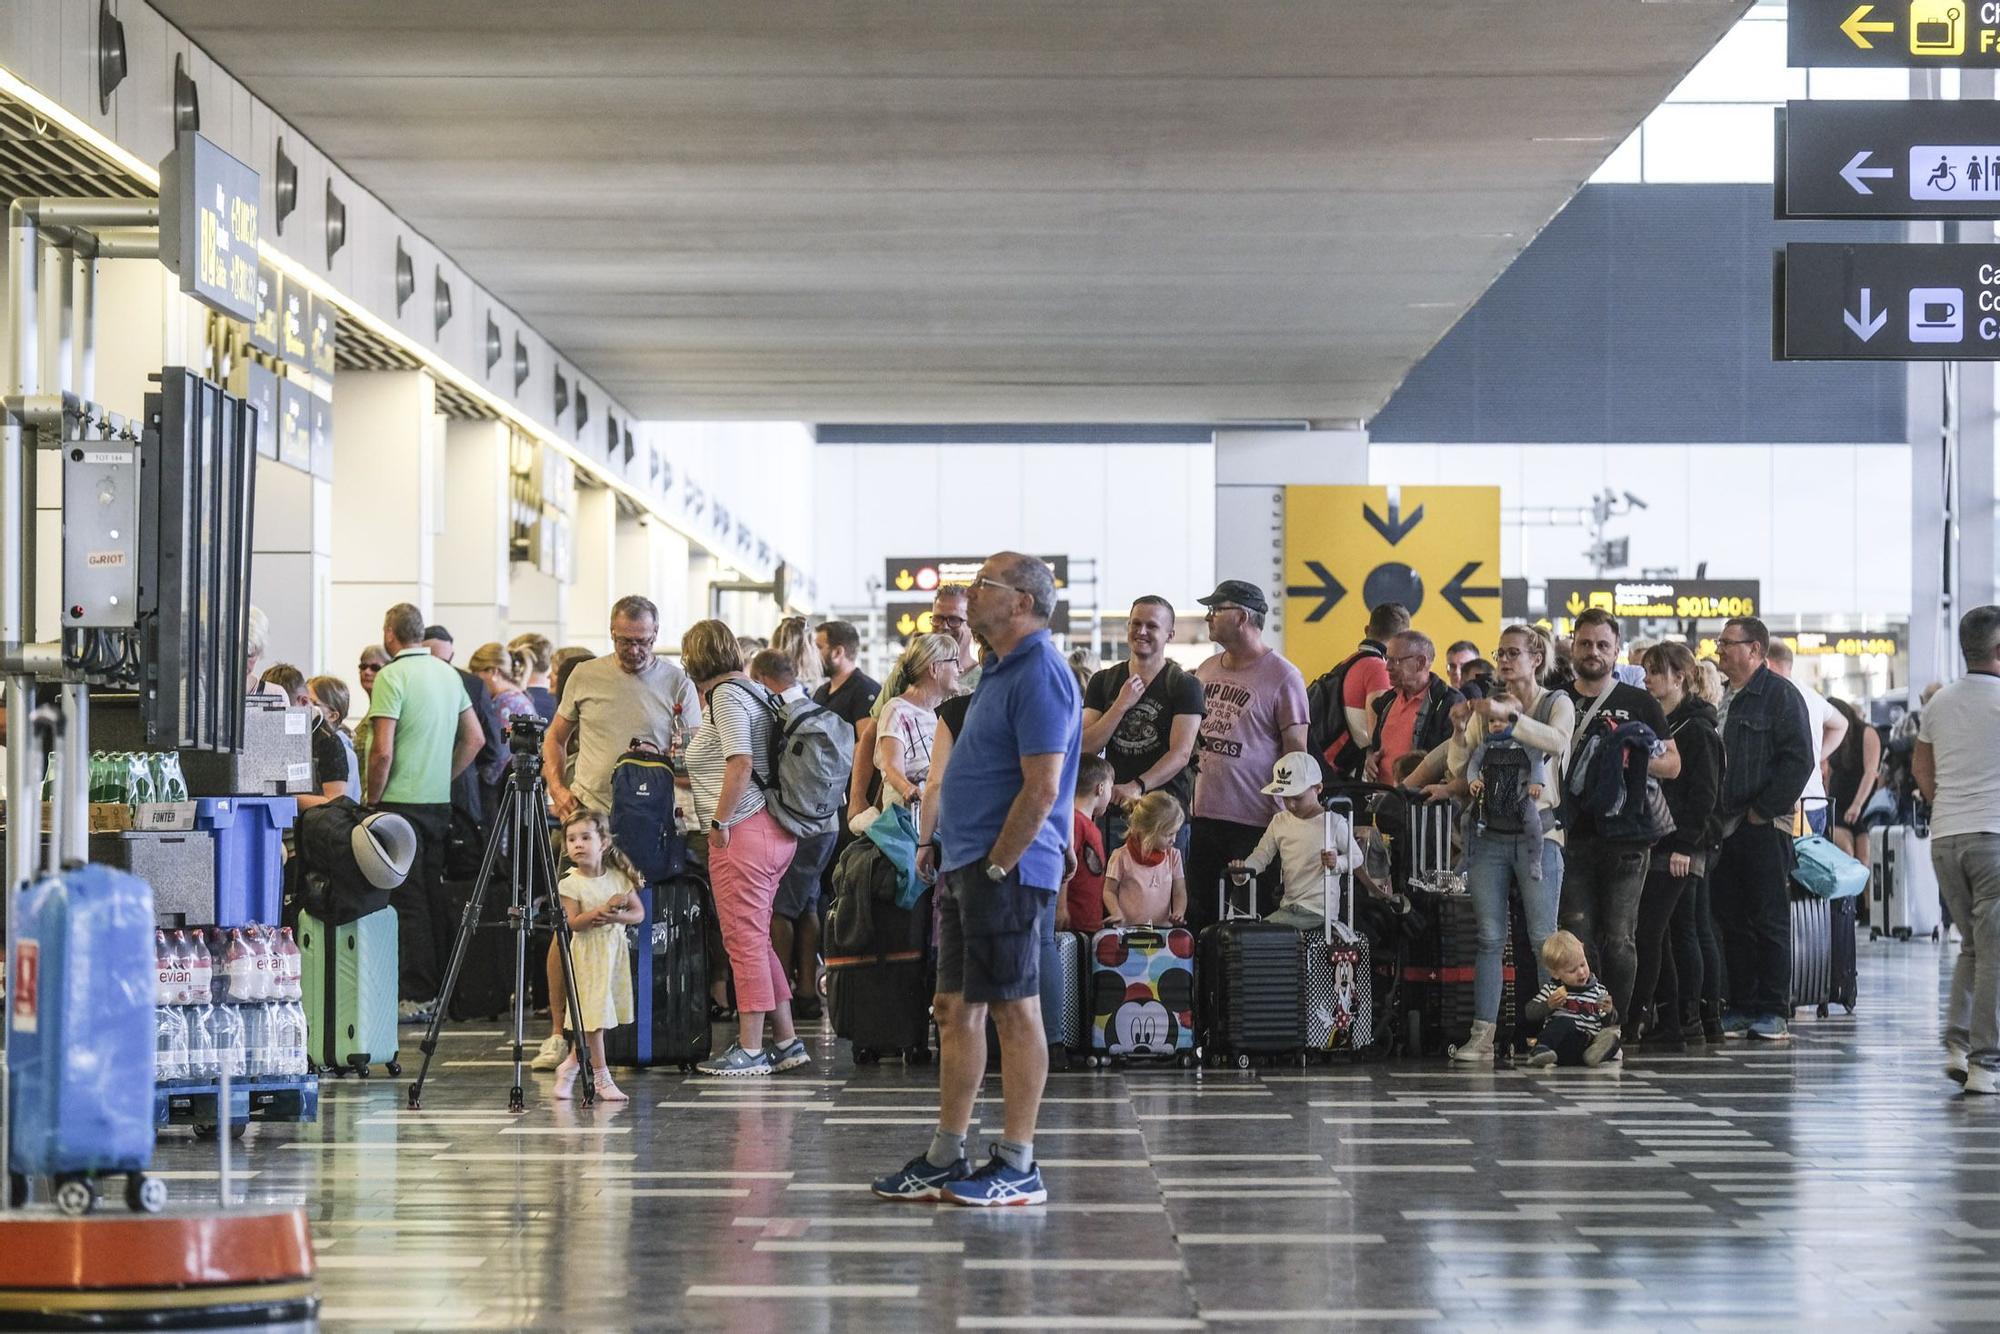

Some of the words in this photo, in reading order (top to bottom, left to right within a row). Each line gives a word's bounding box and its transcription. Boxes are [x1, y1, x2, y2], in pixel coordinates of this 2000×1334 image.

[1979, 317, 2000, 340] C
[1204, 683, 1220, 699] MP
[1220, 685, 1251, 708] DAVID
[1212, 741, 1238, 756] GAS
[159, 969, 191, 983] evian
